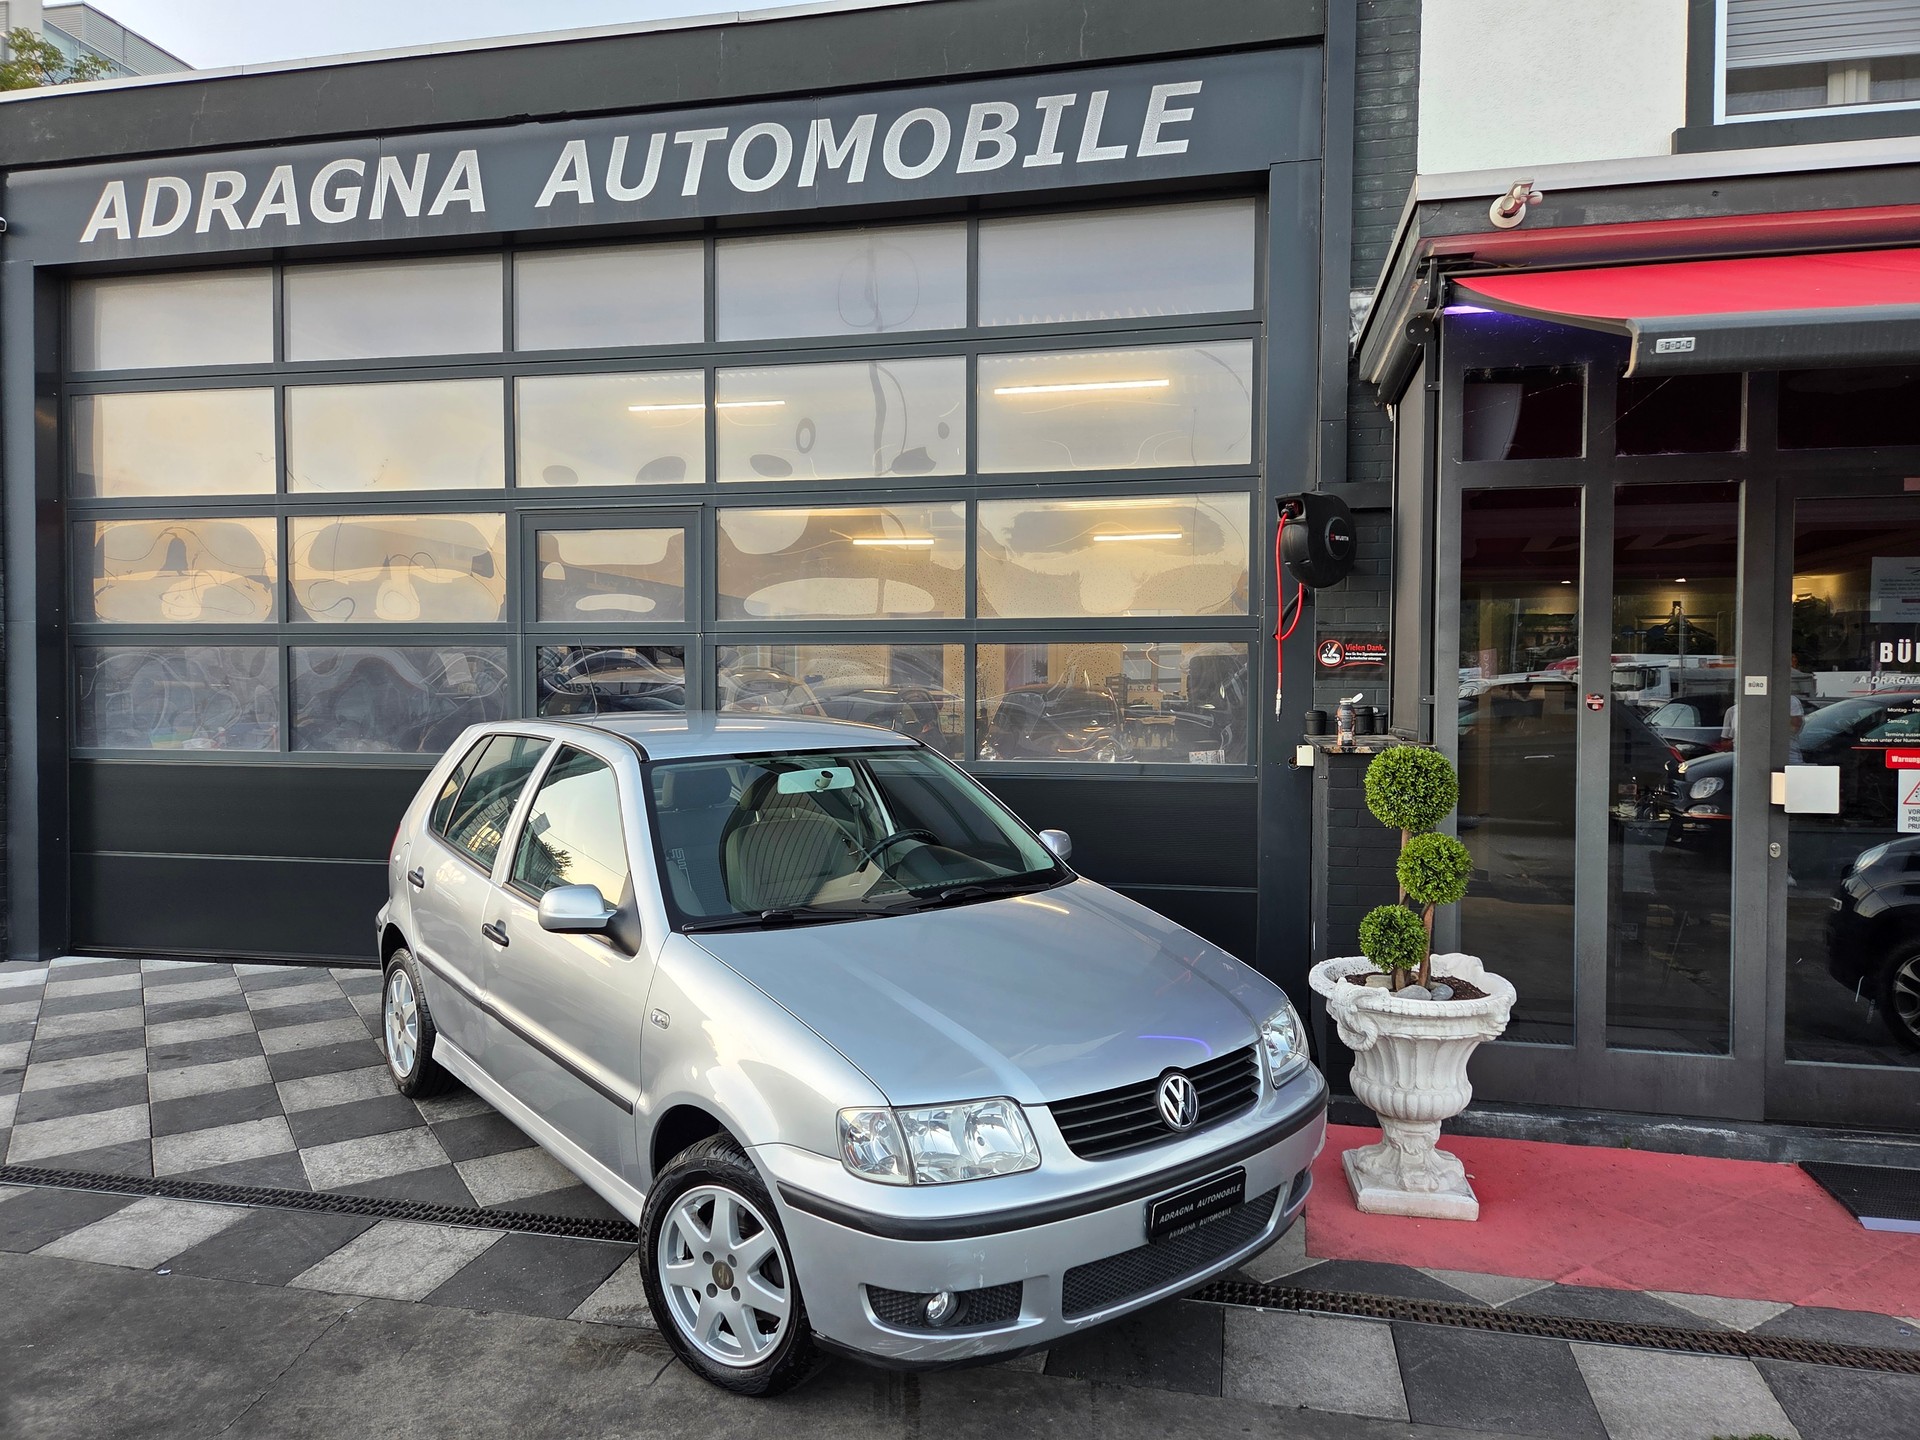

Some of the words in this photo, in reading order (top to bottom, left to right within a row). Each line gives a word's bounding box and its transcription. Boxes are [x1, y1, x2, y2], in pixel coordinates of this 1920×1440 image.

[79, 150, 486, 243] ADRAGNA
[535, 81, 1203, 208] AUTOMOBILE
[1367, 644, 1386, 652] Dank,
[1748, 680, 1764, 688] BÜRO
[1159, 1203, 1194, 1224] ADRAGNA
[1197, 1184, 1242, 1208] AUTOMOBILE
